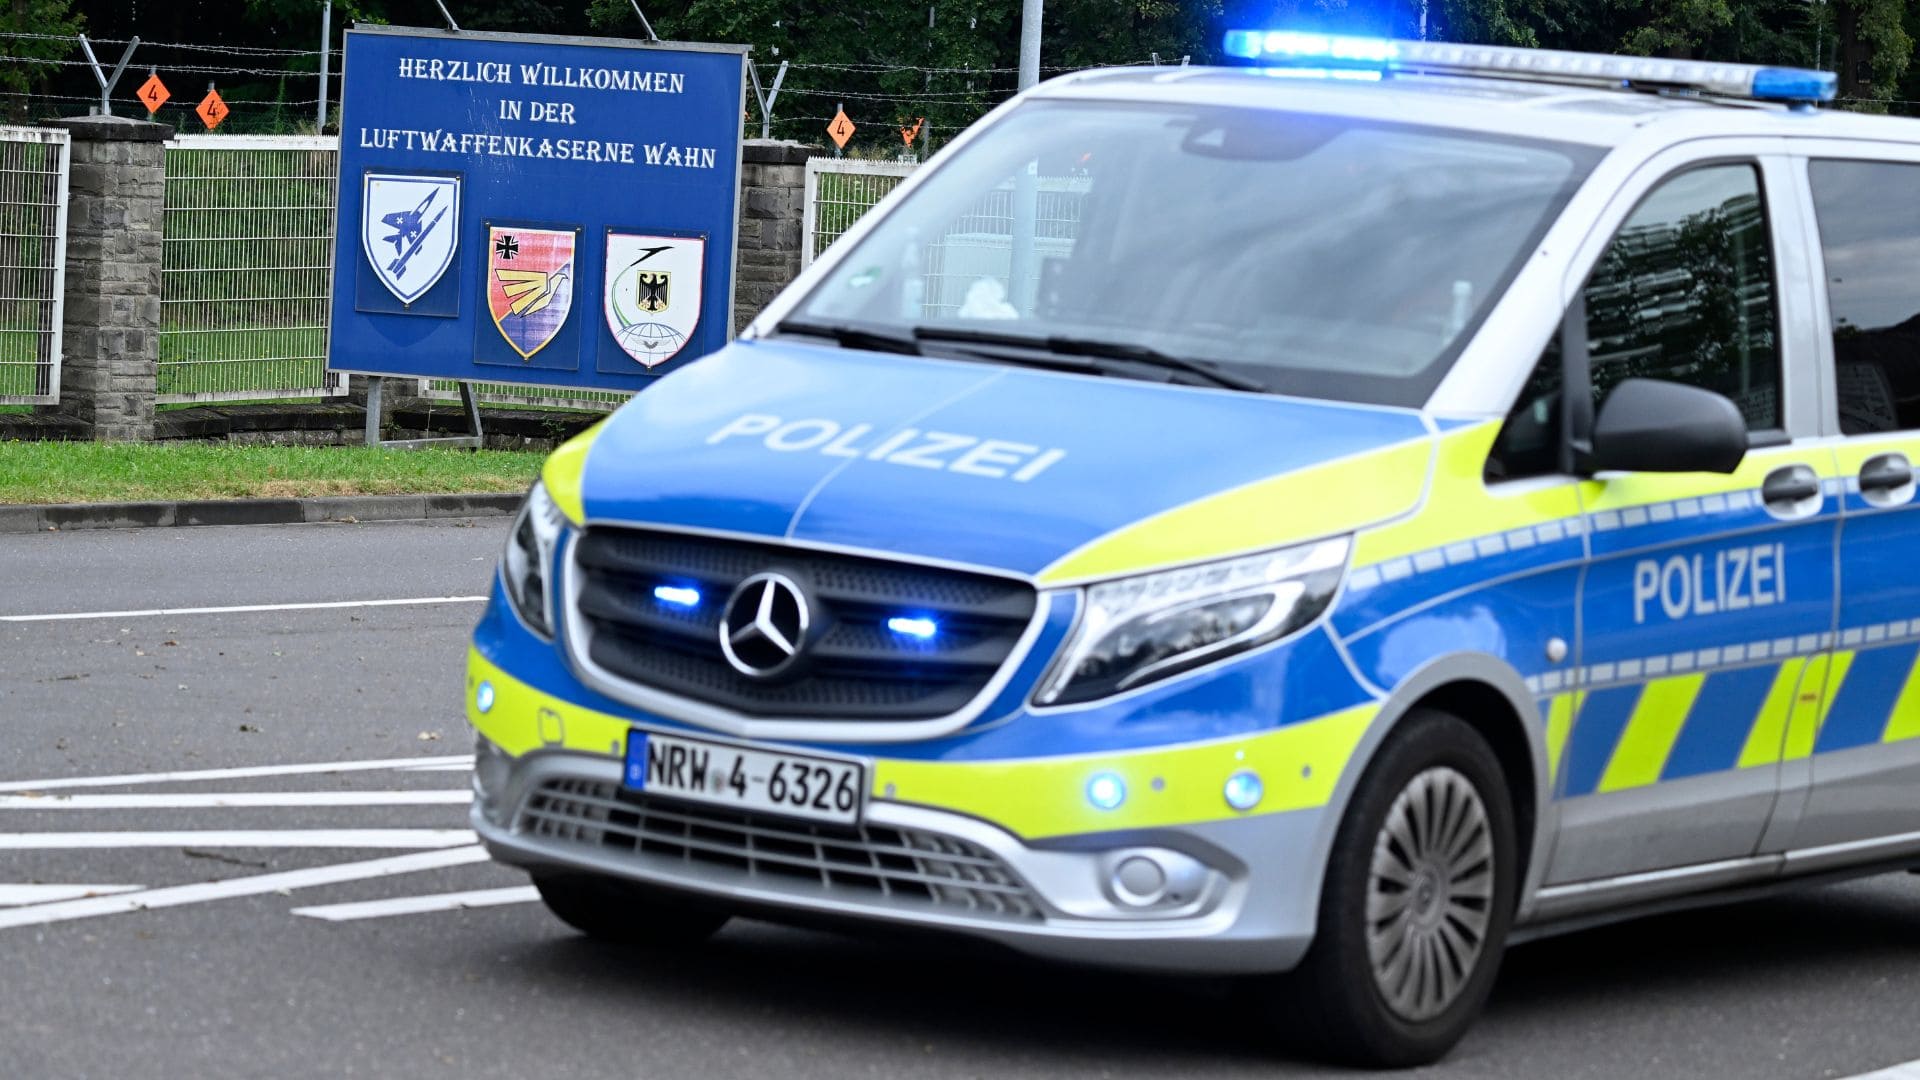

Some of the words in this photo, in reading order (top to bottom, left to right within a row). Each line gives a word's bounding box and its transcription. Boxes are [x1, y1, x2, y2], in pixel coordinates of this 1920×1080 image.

[148, 84, 157, 102] 4
[399, 58, 512, 84] HERZLICH
[521, 62, 685, 94] WILLKOMMEN
[207, 100, 216, 118] 4
[500, 100, 522, 121] IN
[531, 102, 576, 124] DER
[837, 120, 845, 136] 4
[361, 128, 635, 164] LUFTWAFFENKASERNE
[644, 143, 717, 169] WAHN
[706, 414, 1067, 482] POLIZEI
[1634, 542, 1785, 623] POLIZEI
[648, 741, 709, 791] NRW
